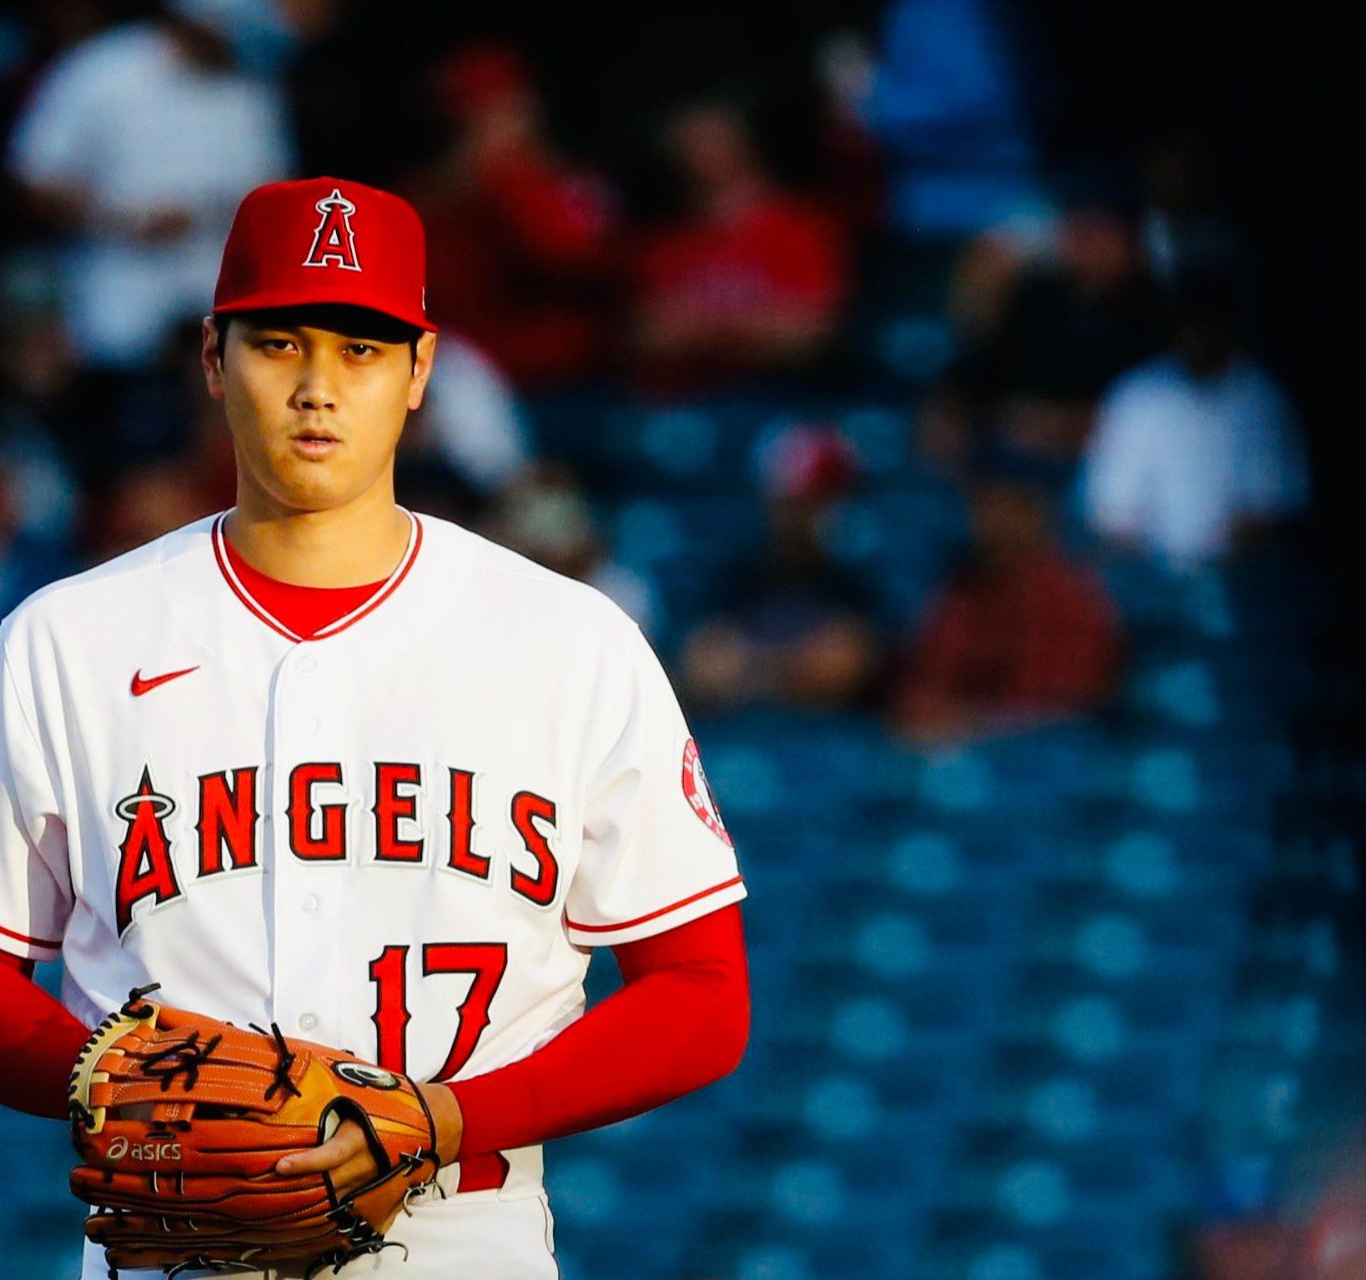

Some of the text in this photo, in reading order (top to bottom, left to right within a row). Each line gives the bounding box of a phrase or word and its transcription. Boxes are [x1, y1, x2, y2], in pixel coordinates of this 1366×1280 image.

[302, 188, 362, 272] A
[114, 761, 559, 939] ANGELS
[368, 942, 508, 1083] 17
